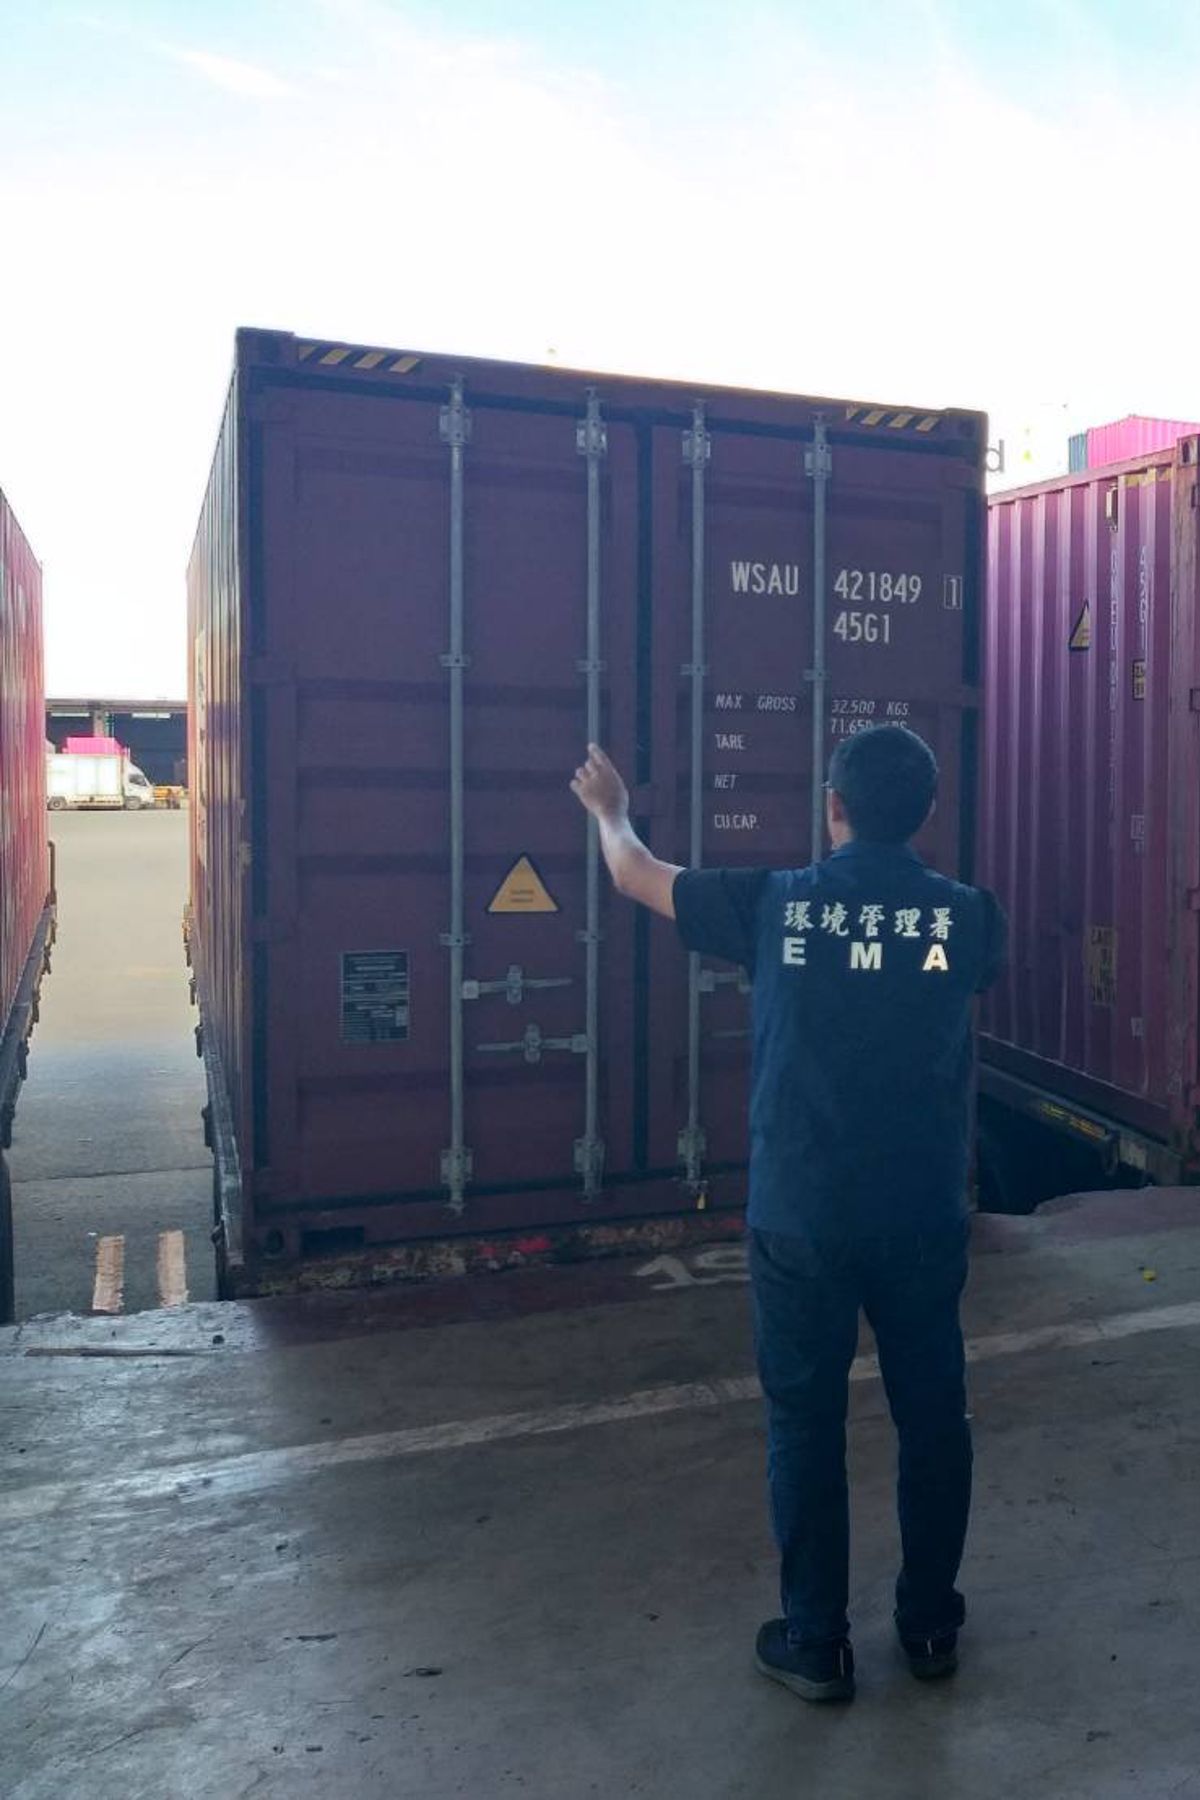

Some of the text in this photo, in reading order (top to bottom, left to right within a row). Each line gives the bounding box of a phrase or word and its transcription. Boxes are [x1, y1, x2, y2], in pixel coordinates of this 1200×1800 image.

[732, 561, 799, 595] WSAU
[834, 569, 921, 603] 421849
[833, 611, 891, 644] 45G1
[716, 694, 742, 709] MAX
[758, 696, 797, 711] GROSS
[715, 734, 746, 750] TARE
[715, 774, 739, 789] NET
[784, 901, 954, 940] 環境管理署
